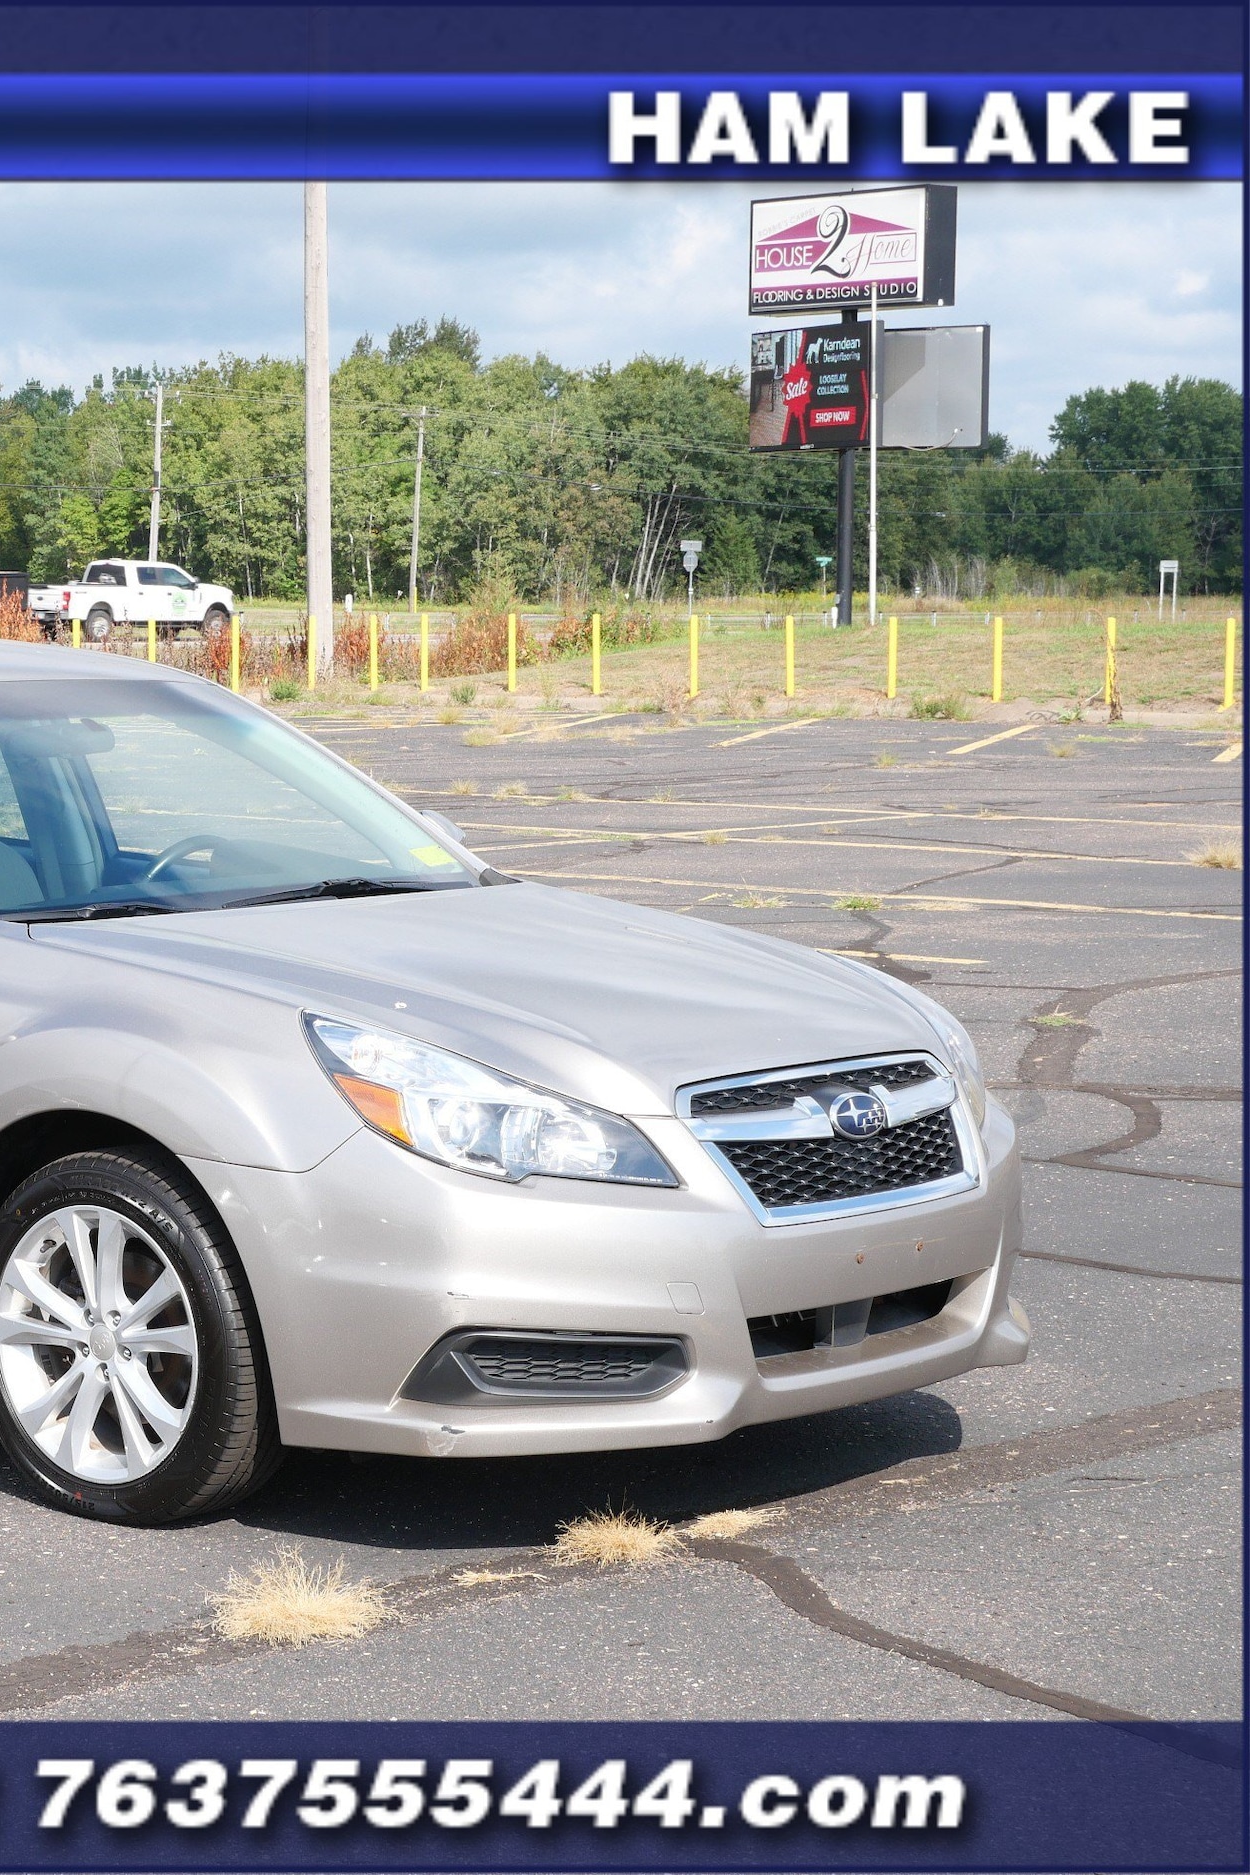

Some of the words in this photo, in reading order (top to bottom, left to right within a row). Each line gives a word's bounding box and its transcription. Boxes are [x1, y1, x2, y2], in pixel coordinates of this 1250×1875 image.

[755, 245, 814, 269] HOUSE
[810, 204, 851, 279] 2
[843, 233, 912, 279] Home
[753, 289, 803, 304] FLOORING
[806, 289, 814, 300] &
[816, 285, 860, 300] DESIGN
[863, 281, 917, 296] SUDIO
[786, 377, 808, 400] Sale
[815, 412, 833, 424] SHOP
[833, 410, 850, 422] NOW
